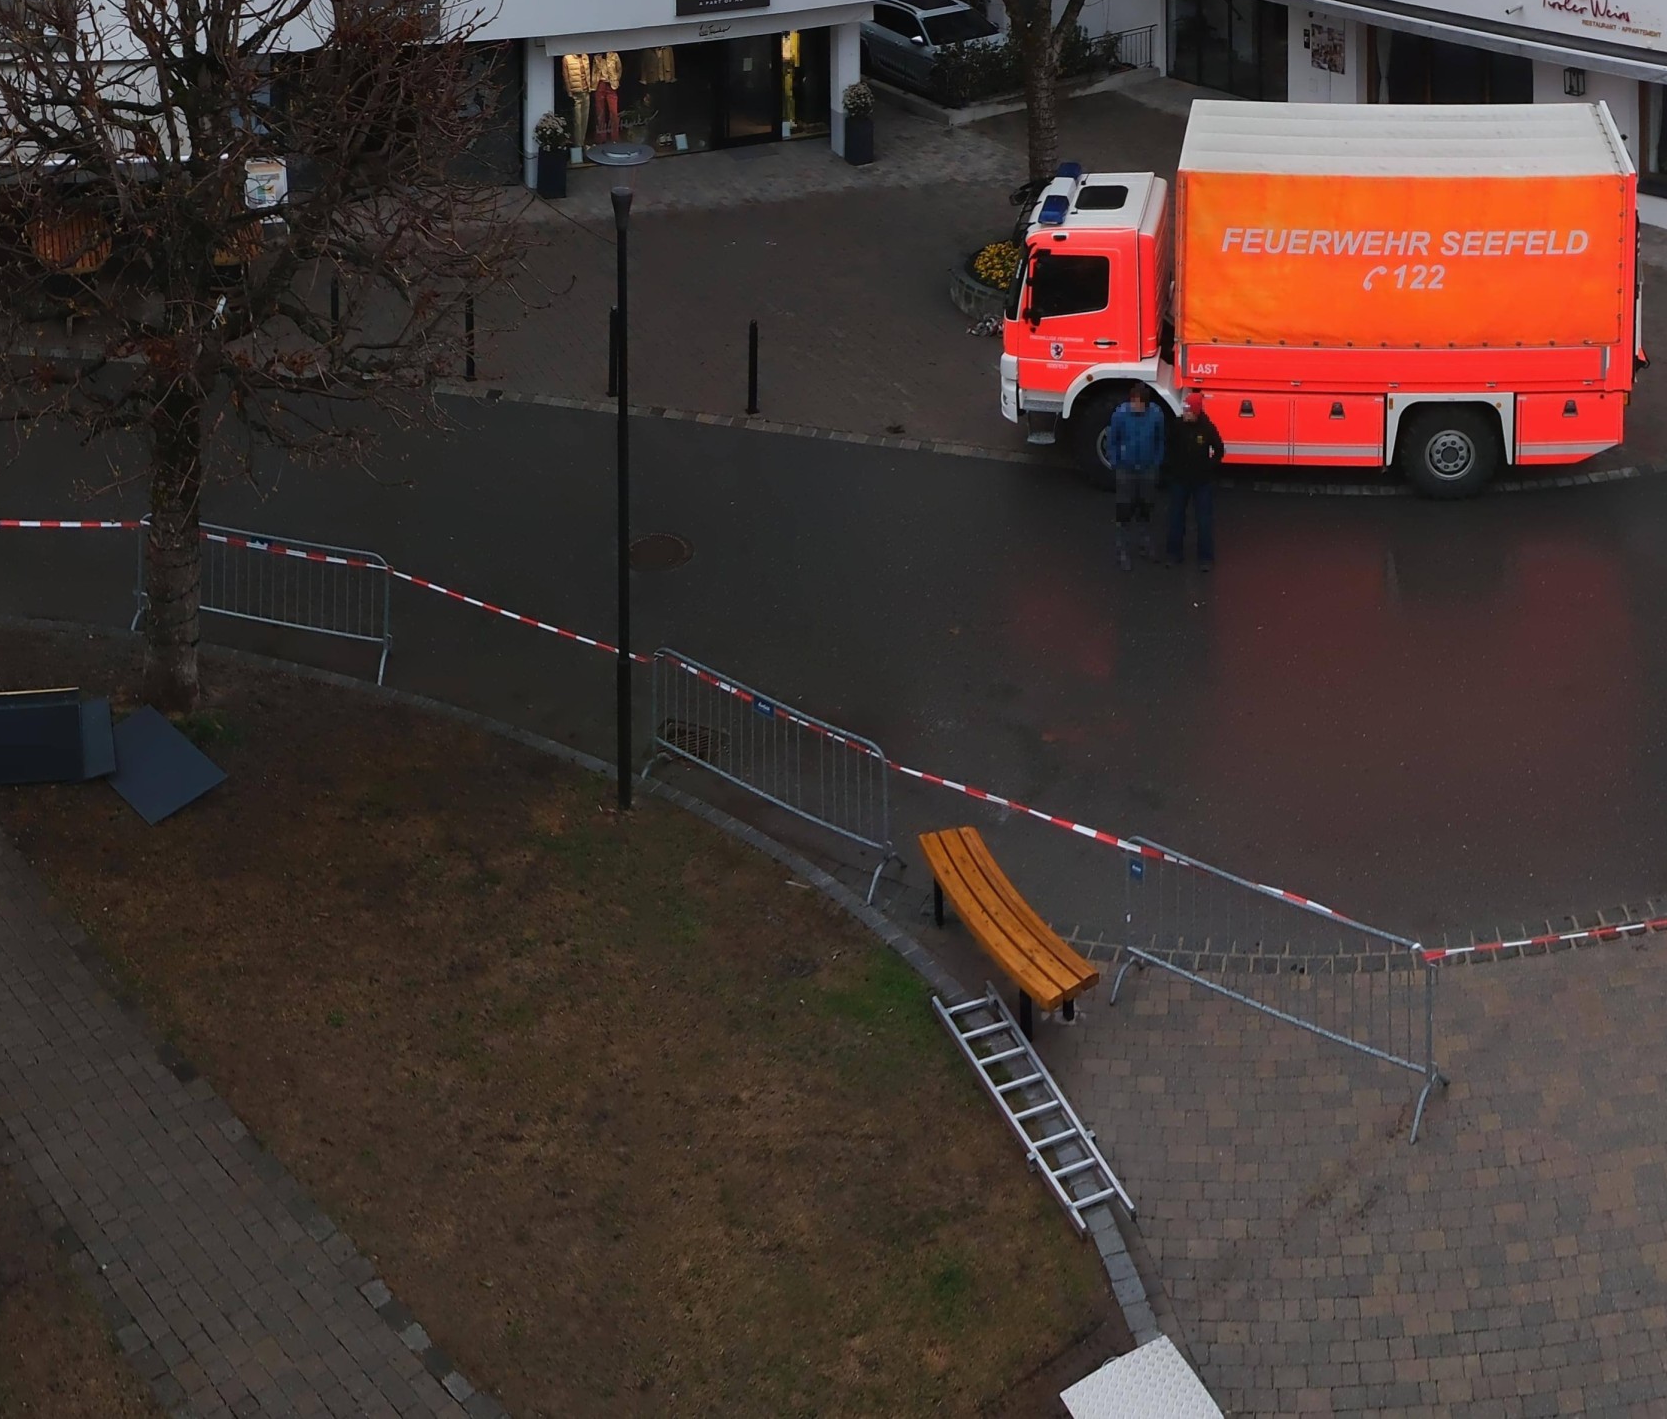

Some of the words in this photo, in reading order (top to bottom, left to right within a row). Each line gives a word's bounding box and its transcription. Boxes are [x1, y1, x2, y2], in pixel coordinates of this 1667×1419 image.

[1221, 227, 1431, 256] FEUERWEHR
[1439, 229, 1590, 256] SEEFELD
[1392, 263, 1447, 290] 122
[1190, 363, 1219, 375] LAST
